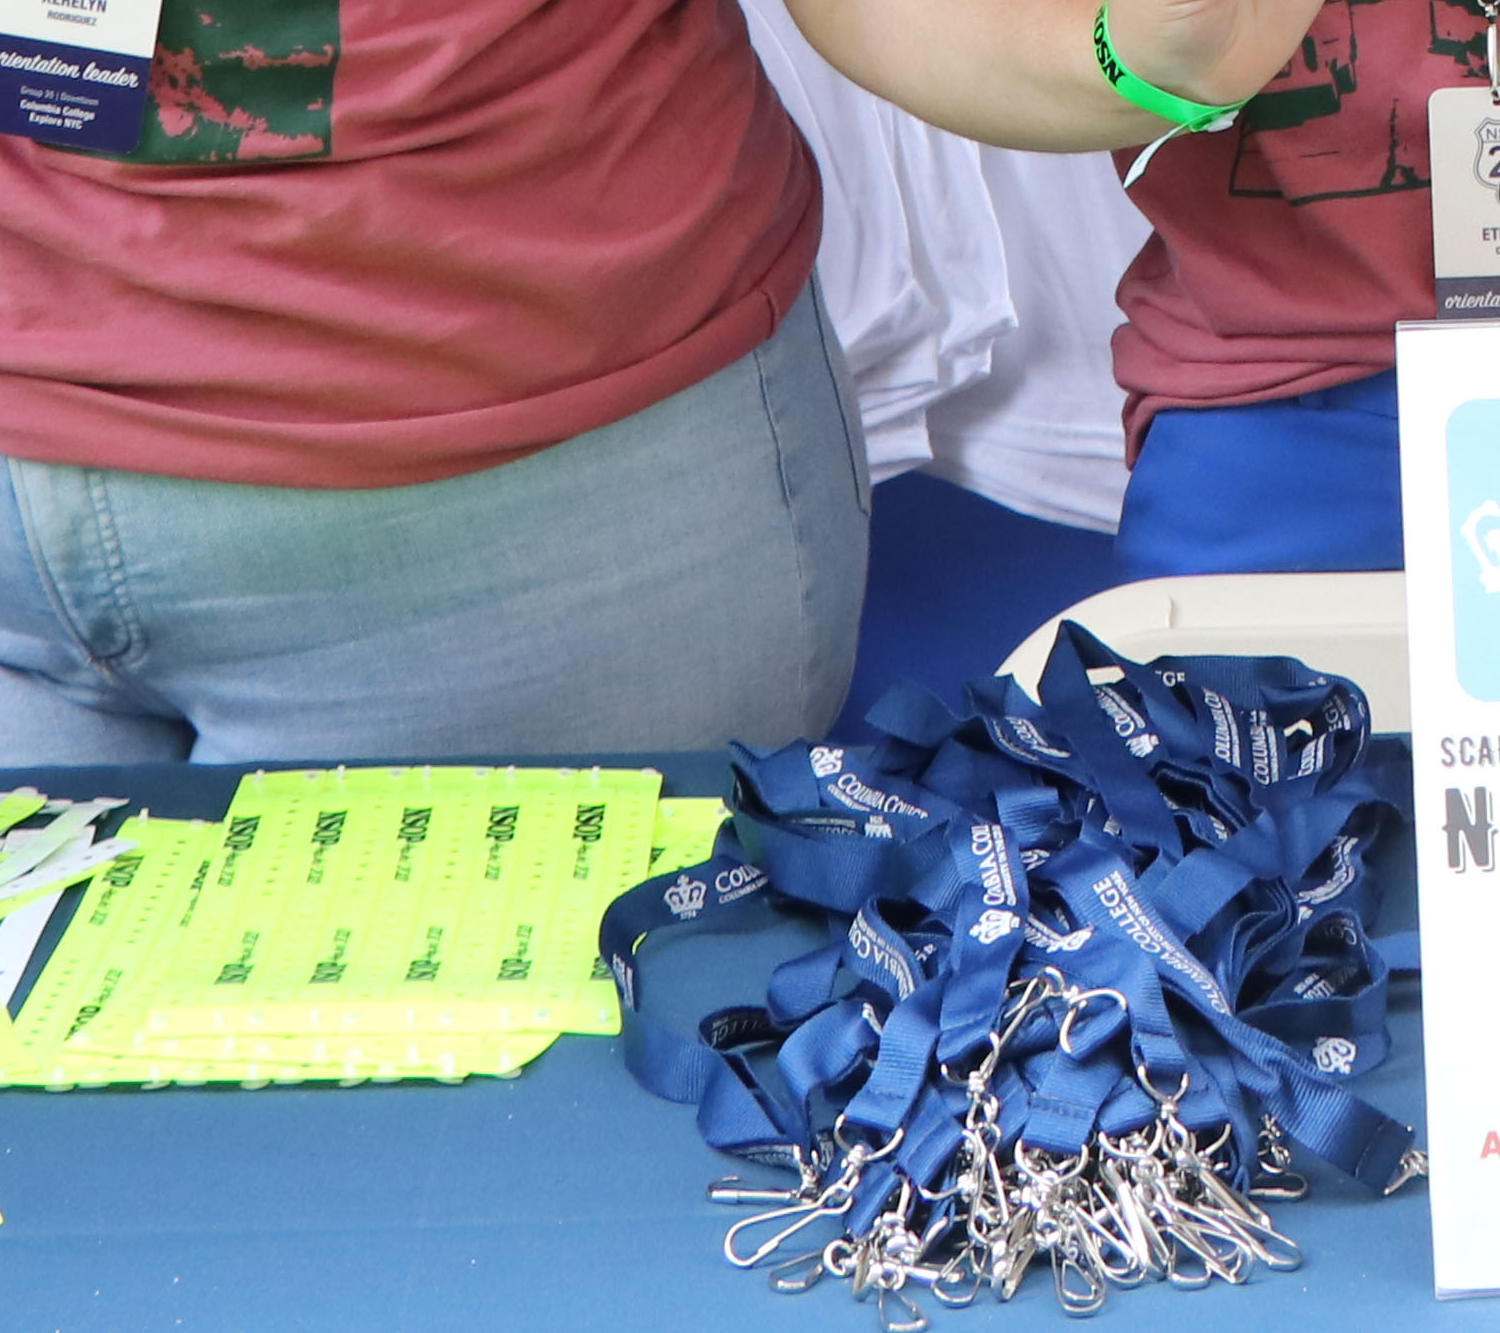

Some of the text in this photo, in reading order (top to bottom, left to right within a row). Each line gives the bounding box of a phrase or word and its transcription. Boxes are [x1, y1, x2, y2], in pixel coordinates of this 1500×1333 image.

[1093, 15, 1126, 87] NSO
[83, 61, 140, 88] leader
[62, 104, 96, 121] College
[396, 801, 432, 846] NSOP
[484, 799, 519, 844] NSOP
[572, 799, 606, 844] NSOP
[1091, 878, 1231, 1015] OLUMBIA COLLEGE
